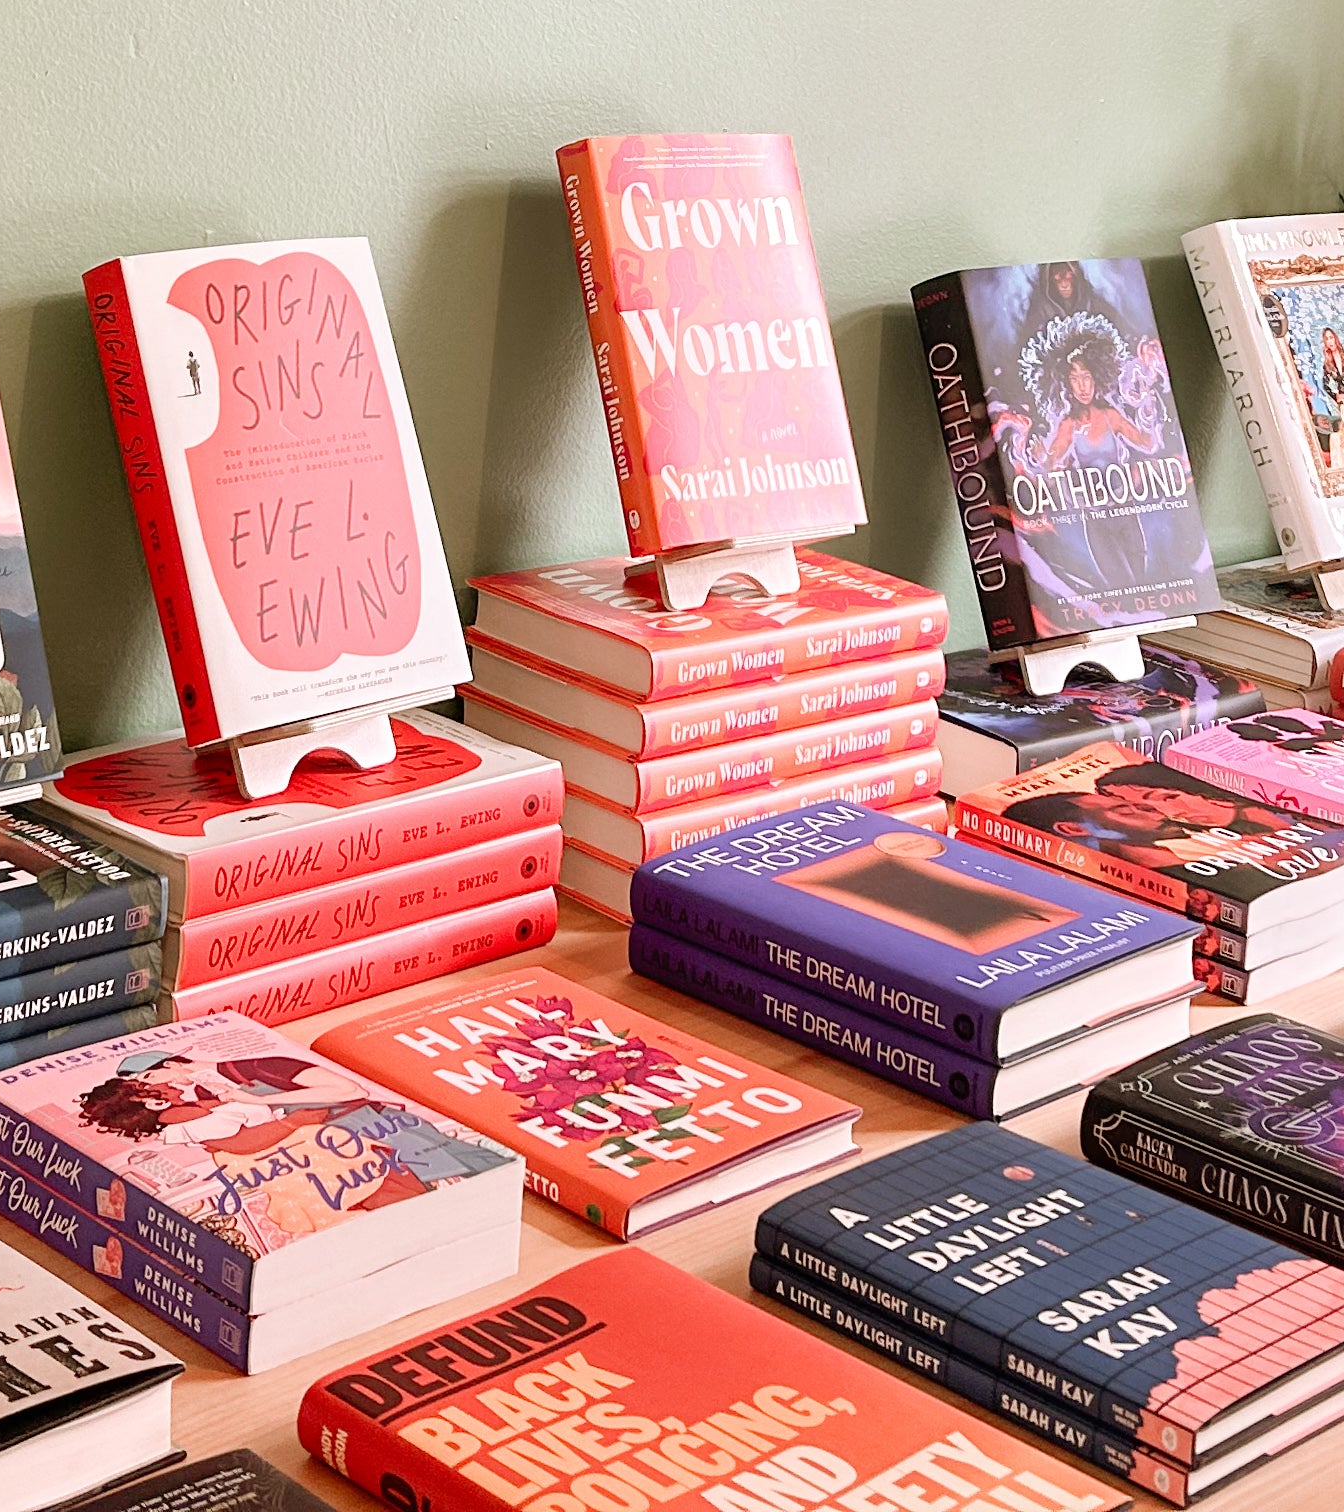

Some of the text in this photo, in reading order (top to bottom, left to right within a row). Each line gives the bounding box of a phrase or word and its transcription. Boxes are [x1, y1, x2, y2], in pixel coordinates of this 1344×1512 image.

[621, 182, 799, 251] Grown
[206, 268, 381, 418] ORIGINAL
[618, 307, 831, 381] Women
[1188, 244, 1274, 469] MATRIARCH
[232, 339, 324, 430] SINS
[660, 454, 850, 502] Sarai Johnson
[927, 341, 1007, 593] OATHBOUND
[1013, 457, 1187, 516] OATHBOUND
[229, 479, 369, 569] EVE L.
[257, 531, 409, 647] EWING
[678, 623, 901, 683] Grown Women Sarai Johnson
[214, 807, 501, 900] ORIGINAL SINS EVE L. EWING
[652, 804, 866, 879] THE DREAM
[734, 833, 863, 876] HOTEL
[962, 809, 1175, 898] NO ORDINARY Love MYAH ARIEL
[764, 939, 947, 1031] THE DREAM HOTEL
[956, 909, 1150, 989] LAILA LALAMI
[0, 1049, 100, 1085] DENISE
[104, 1015, 229, 1053] WILLIAMS
[393, 996, 567, 1060] HAIL
[432, 1017, 630, 1096] MARY
[1173, 1026, 1323, 1100] CHAOS
[517, 1054, 749, 1149] FUNMI
[585, 1085, 803, 1179] FETTO
[12, 1121, 46, 1164] Our
[44, 1143, 83, 1192] Luck
[203, 1110, 422, 1216] Just Our
[306, 1144, 432, 1212] Luck
[1119, 1142, 1189, 1185] CALLENDER
[1134, 1130, 1175, 1162] KACEN
[826, 1204, 870, 1230] A
[863, 1191, 991, 1252] LITTLE
[1200, 1161, 1292, 1226] CHAOS
[905, 1187, 1087, 1275] DAYLIGHT
[780, 1242, 948, 1337] A LITTLE DAYLIGHT LEFT
[951, 1245, 1050, 1297] LEFT
[1036, 1263, 1172, 1334] SARAH
[324, 1293, 589, 1420] DEFUND
[1081, 1305, 1179, 1362] KAY
[397, 1349, 636, 1466] BLACK
